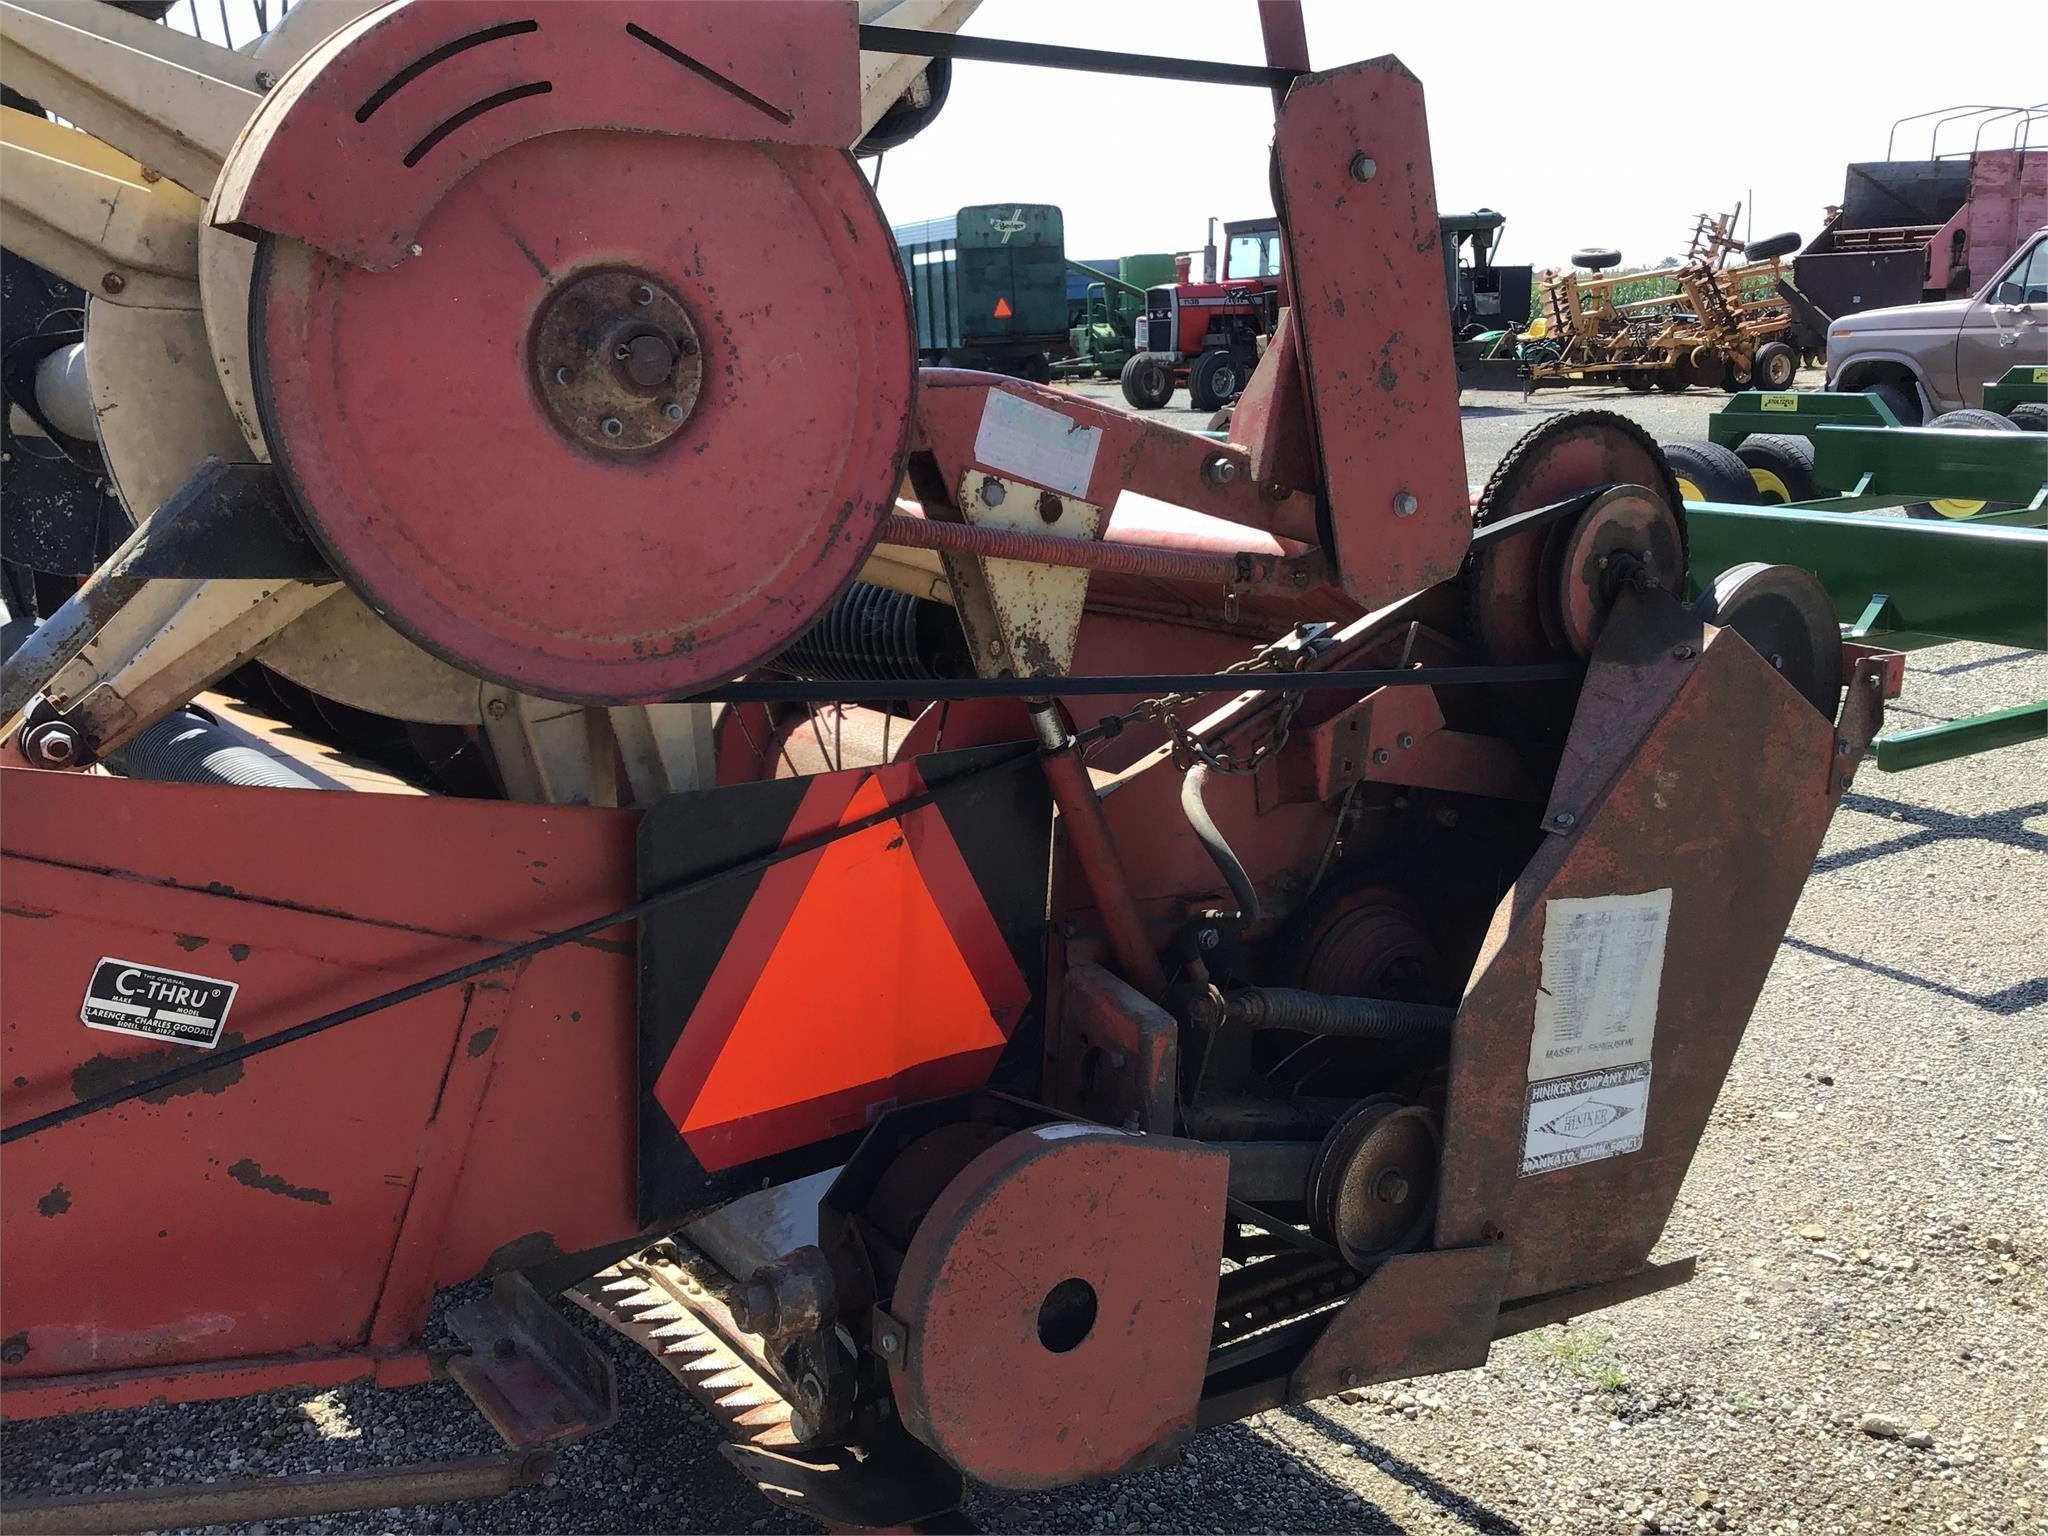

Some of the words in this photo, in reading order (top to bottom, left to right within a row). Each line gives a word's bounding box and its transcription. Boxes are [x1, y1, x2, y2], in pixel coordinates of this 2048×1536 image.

[111, 995, 133, 1004] MAKE
[176, 1007, 200, 1017] MODEL
[86, 1007, 126, 1021] LARENCE
[134, 1017, 171, 1029] CHARLES
[173, 1024, 214, 1037] GOODALL
[1532, 1082, 1573, 1099] HINIKER
[1574, 1071, 1625, 1091] COMPANY
